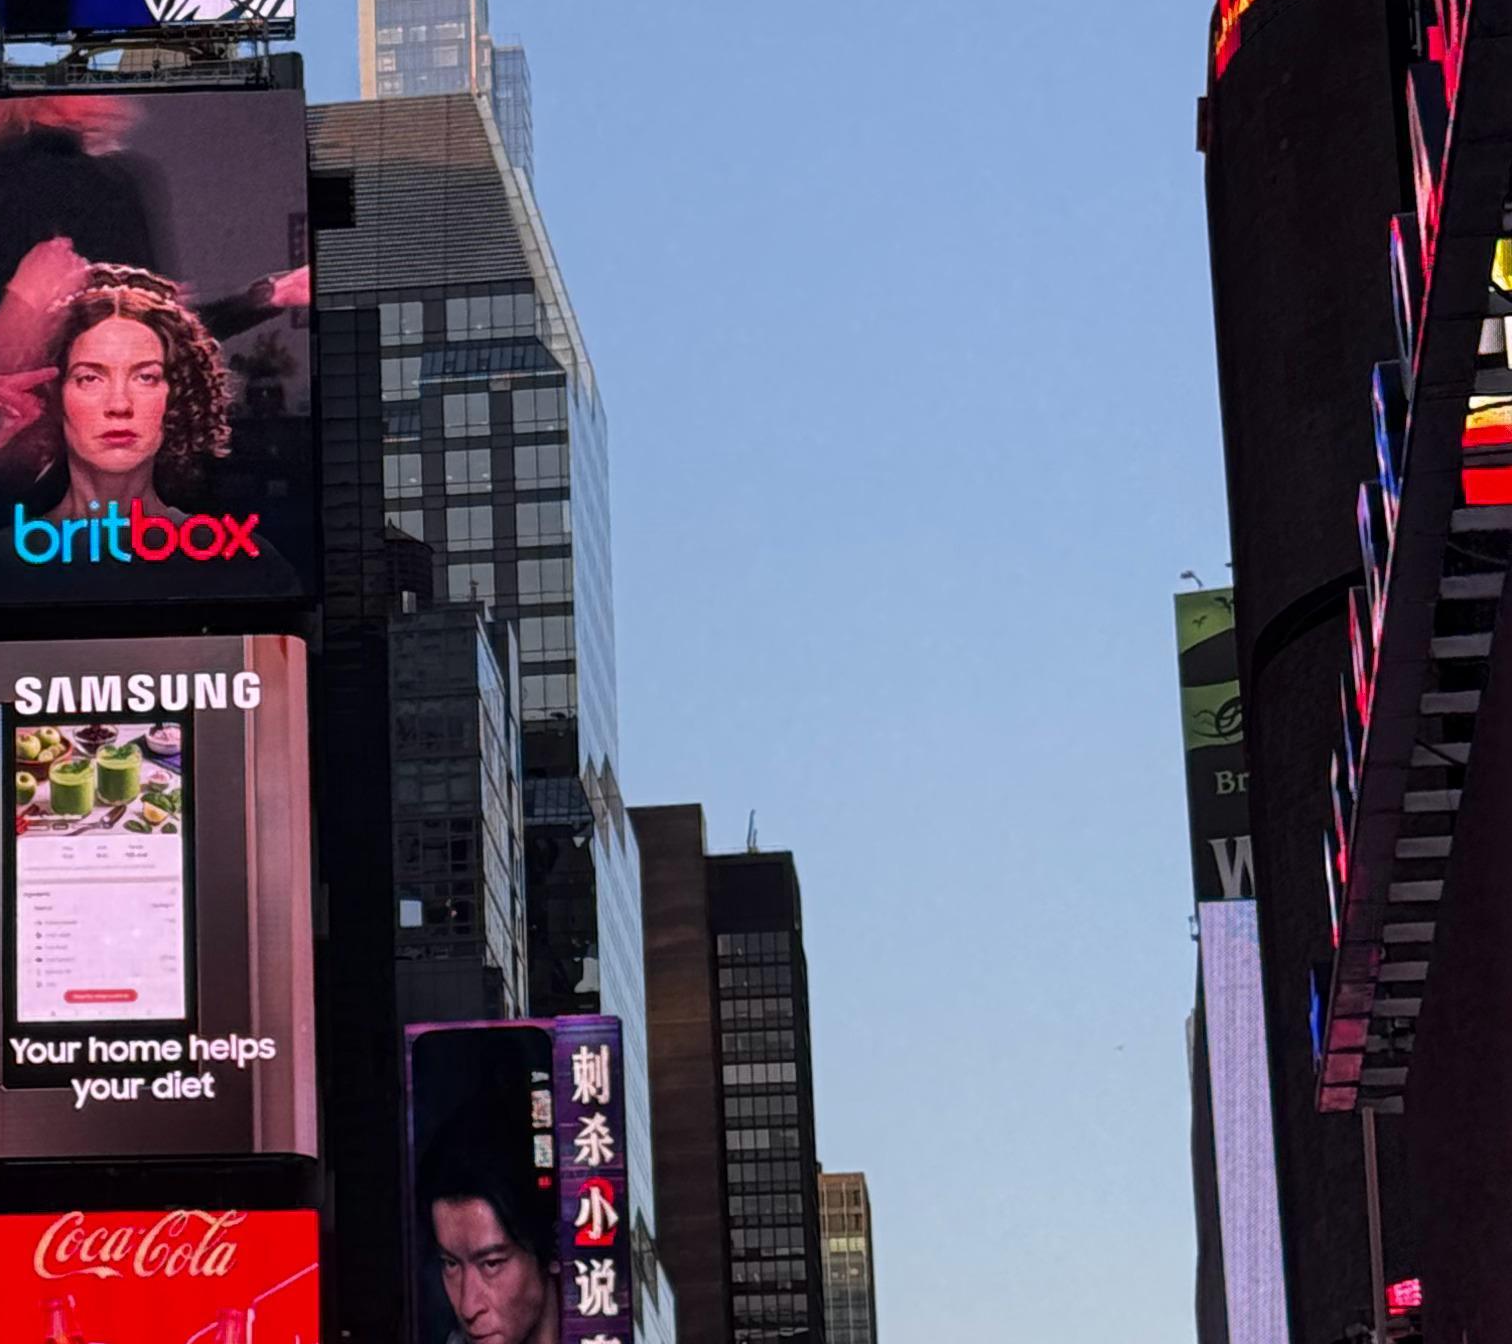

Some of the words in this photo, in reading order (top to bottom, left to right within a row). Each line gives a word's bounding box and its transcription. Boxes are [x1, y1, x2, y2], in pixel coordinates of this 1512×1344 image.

[13, 497, 261, 564] britbox
[14, 672, 261, 715] SAMSUNG
[9, 1037, 82, 1064] Your
[88, 1034, 184, 1063] home
[189, 1033, 276, 1069] helps
[71, 1077, 145, 1109] your
[151, 1070, 216, 1100] diet
[33, 1209, 247, 1279] Coca-Cola
